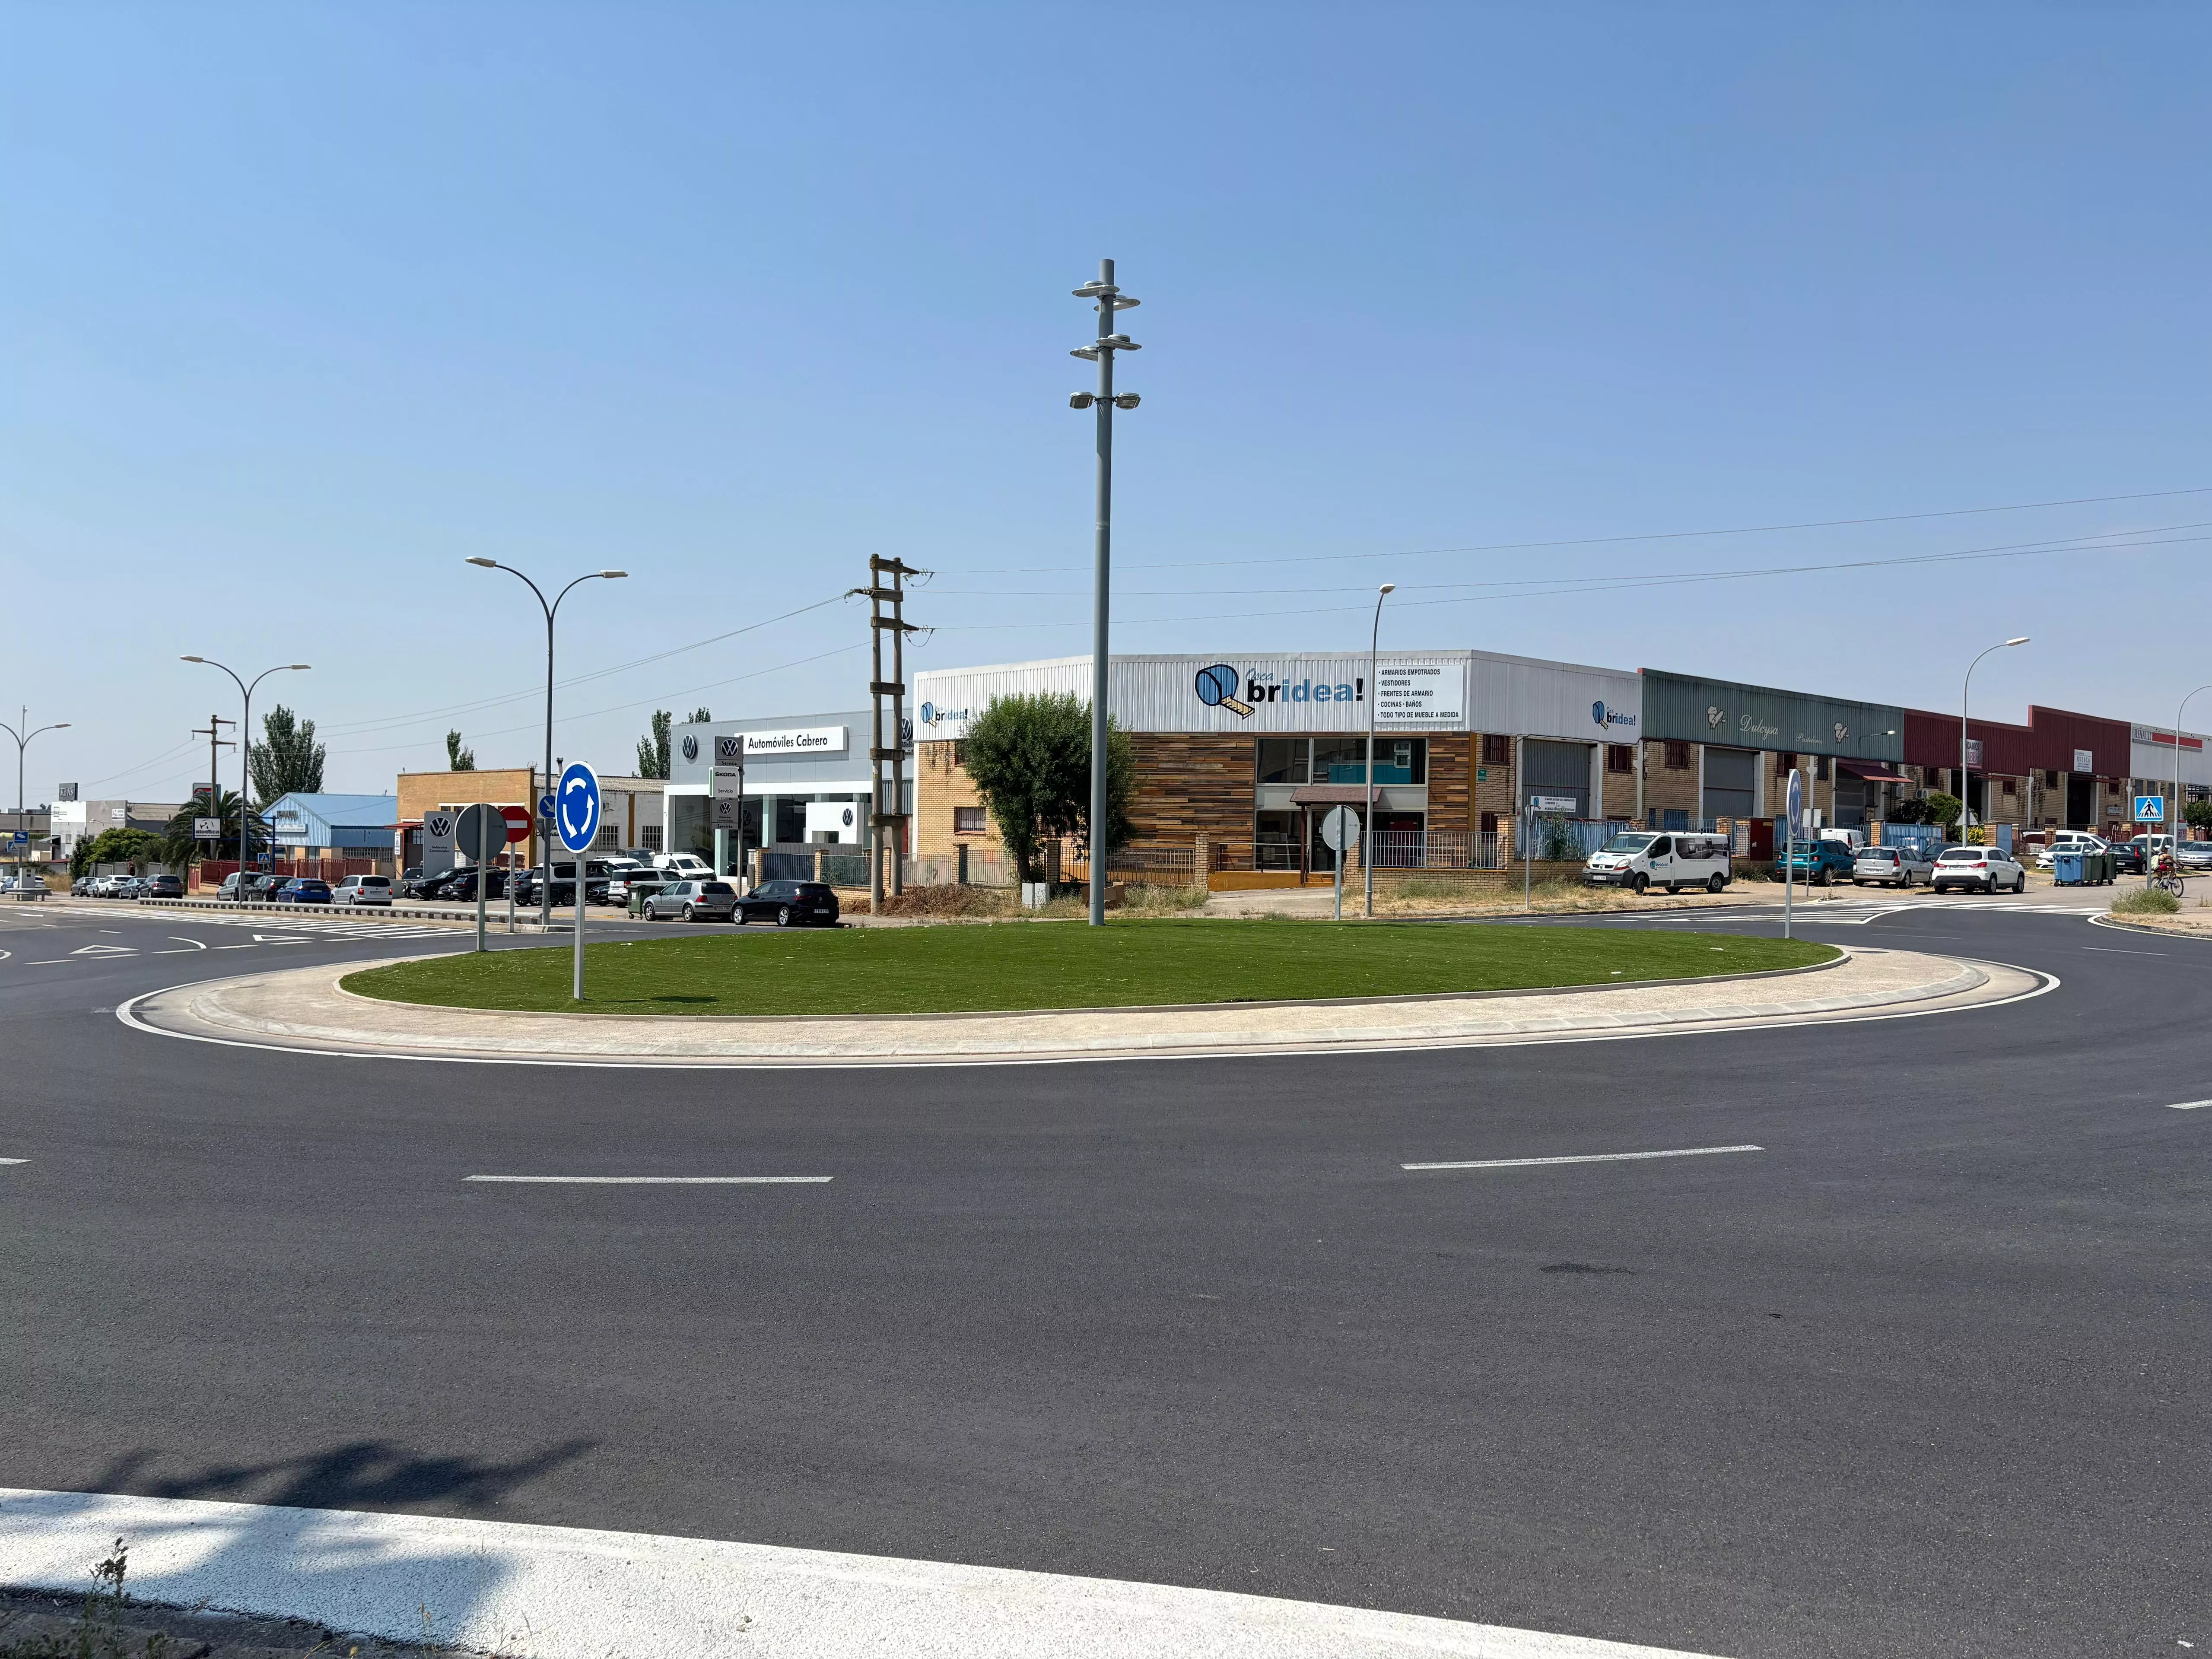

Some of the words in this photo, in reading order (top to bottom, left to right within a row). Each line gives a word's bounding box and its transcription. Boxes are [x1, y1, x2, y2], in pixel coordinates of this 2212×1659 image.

[1247, 678, 1363, 702] bridea!
[935, 709, 968, 721] bridea!
[1607, 712, 1636, 726] bridea!
[748, 735, 794, 749] Automóviles
[796, 734, 828, 747] Cabrero
